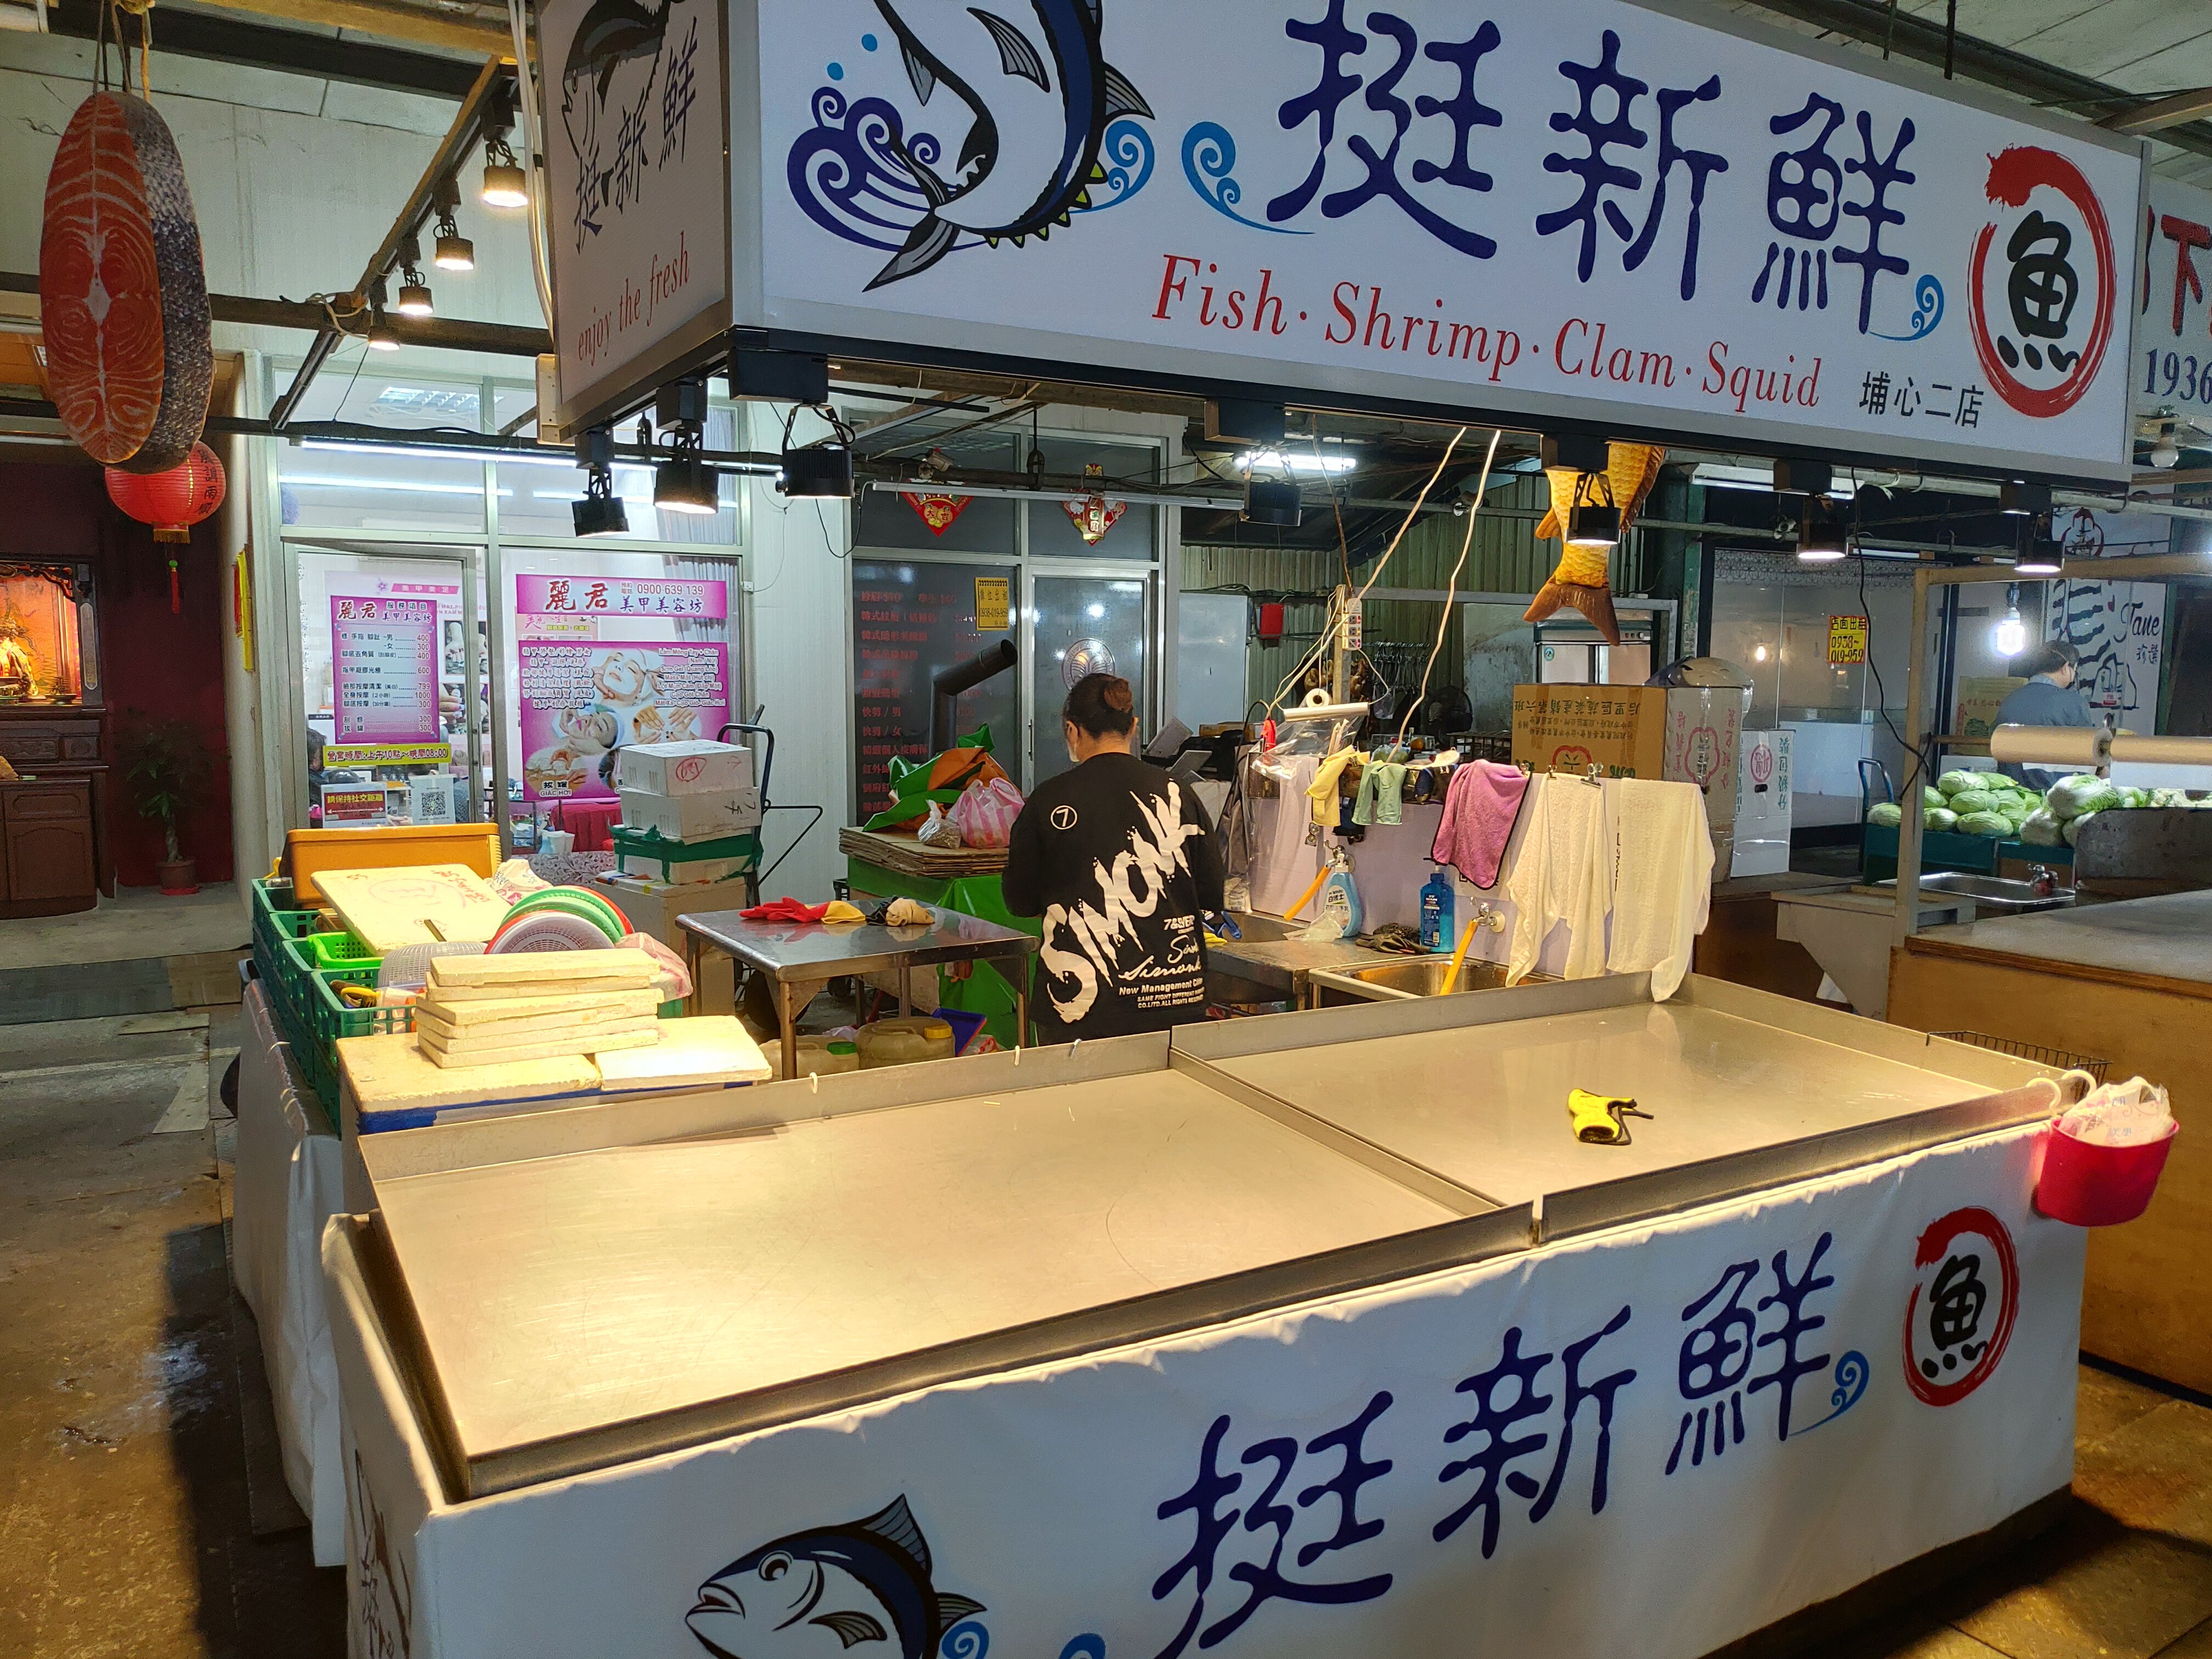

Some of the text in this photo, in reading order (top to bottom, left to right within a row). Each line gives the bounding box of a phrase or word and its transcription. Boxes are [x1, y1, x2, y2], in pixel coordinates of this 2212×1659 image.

[574, 16, 697, 255] 挺新鮮
[1266, 0, 1916, 335] 挺新鮮
[578, 230, 691, 366] enjoy the fresh
[1997, 210, 2081, 373] 魚
[1703, 341, 1821, 412] Squid
[1859, 371, 1985, 429] 埔心二店
[337, 601, 426, 619] 麗君 服務項目
[382, 612, 432, 622] 美甲美容坊
[545, 580, 609, 610] 麗君
[637, 584, 704, 596] 0900-639-139
[620, 595, 702, 613] 美甲美容坊
[1831, 616, 1866, 630] 店面出租
[1831, 648, 1864, 663] 019-959
[1778, 737, 1790, 810] 分級包裝
[1921, 1254, 1989, 1379] 魚
[1150, 1231, 1834, 1659] 挺新鮮
